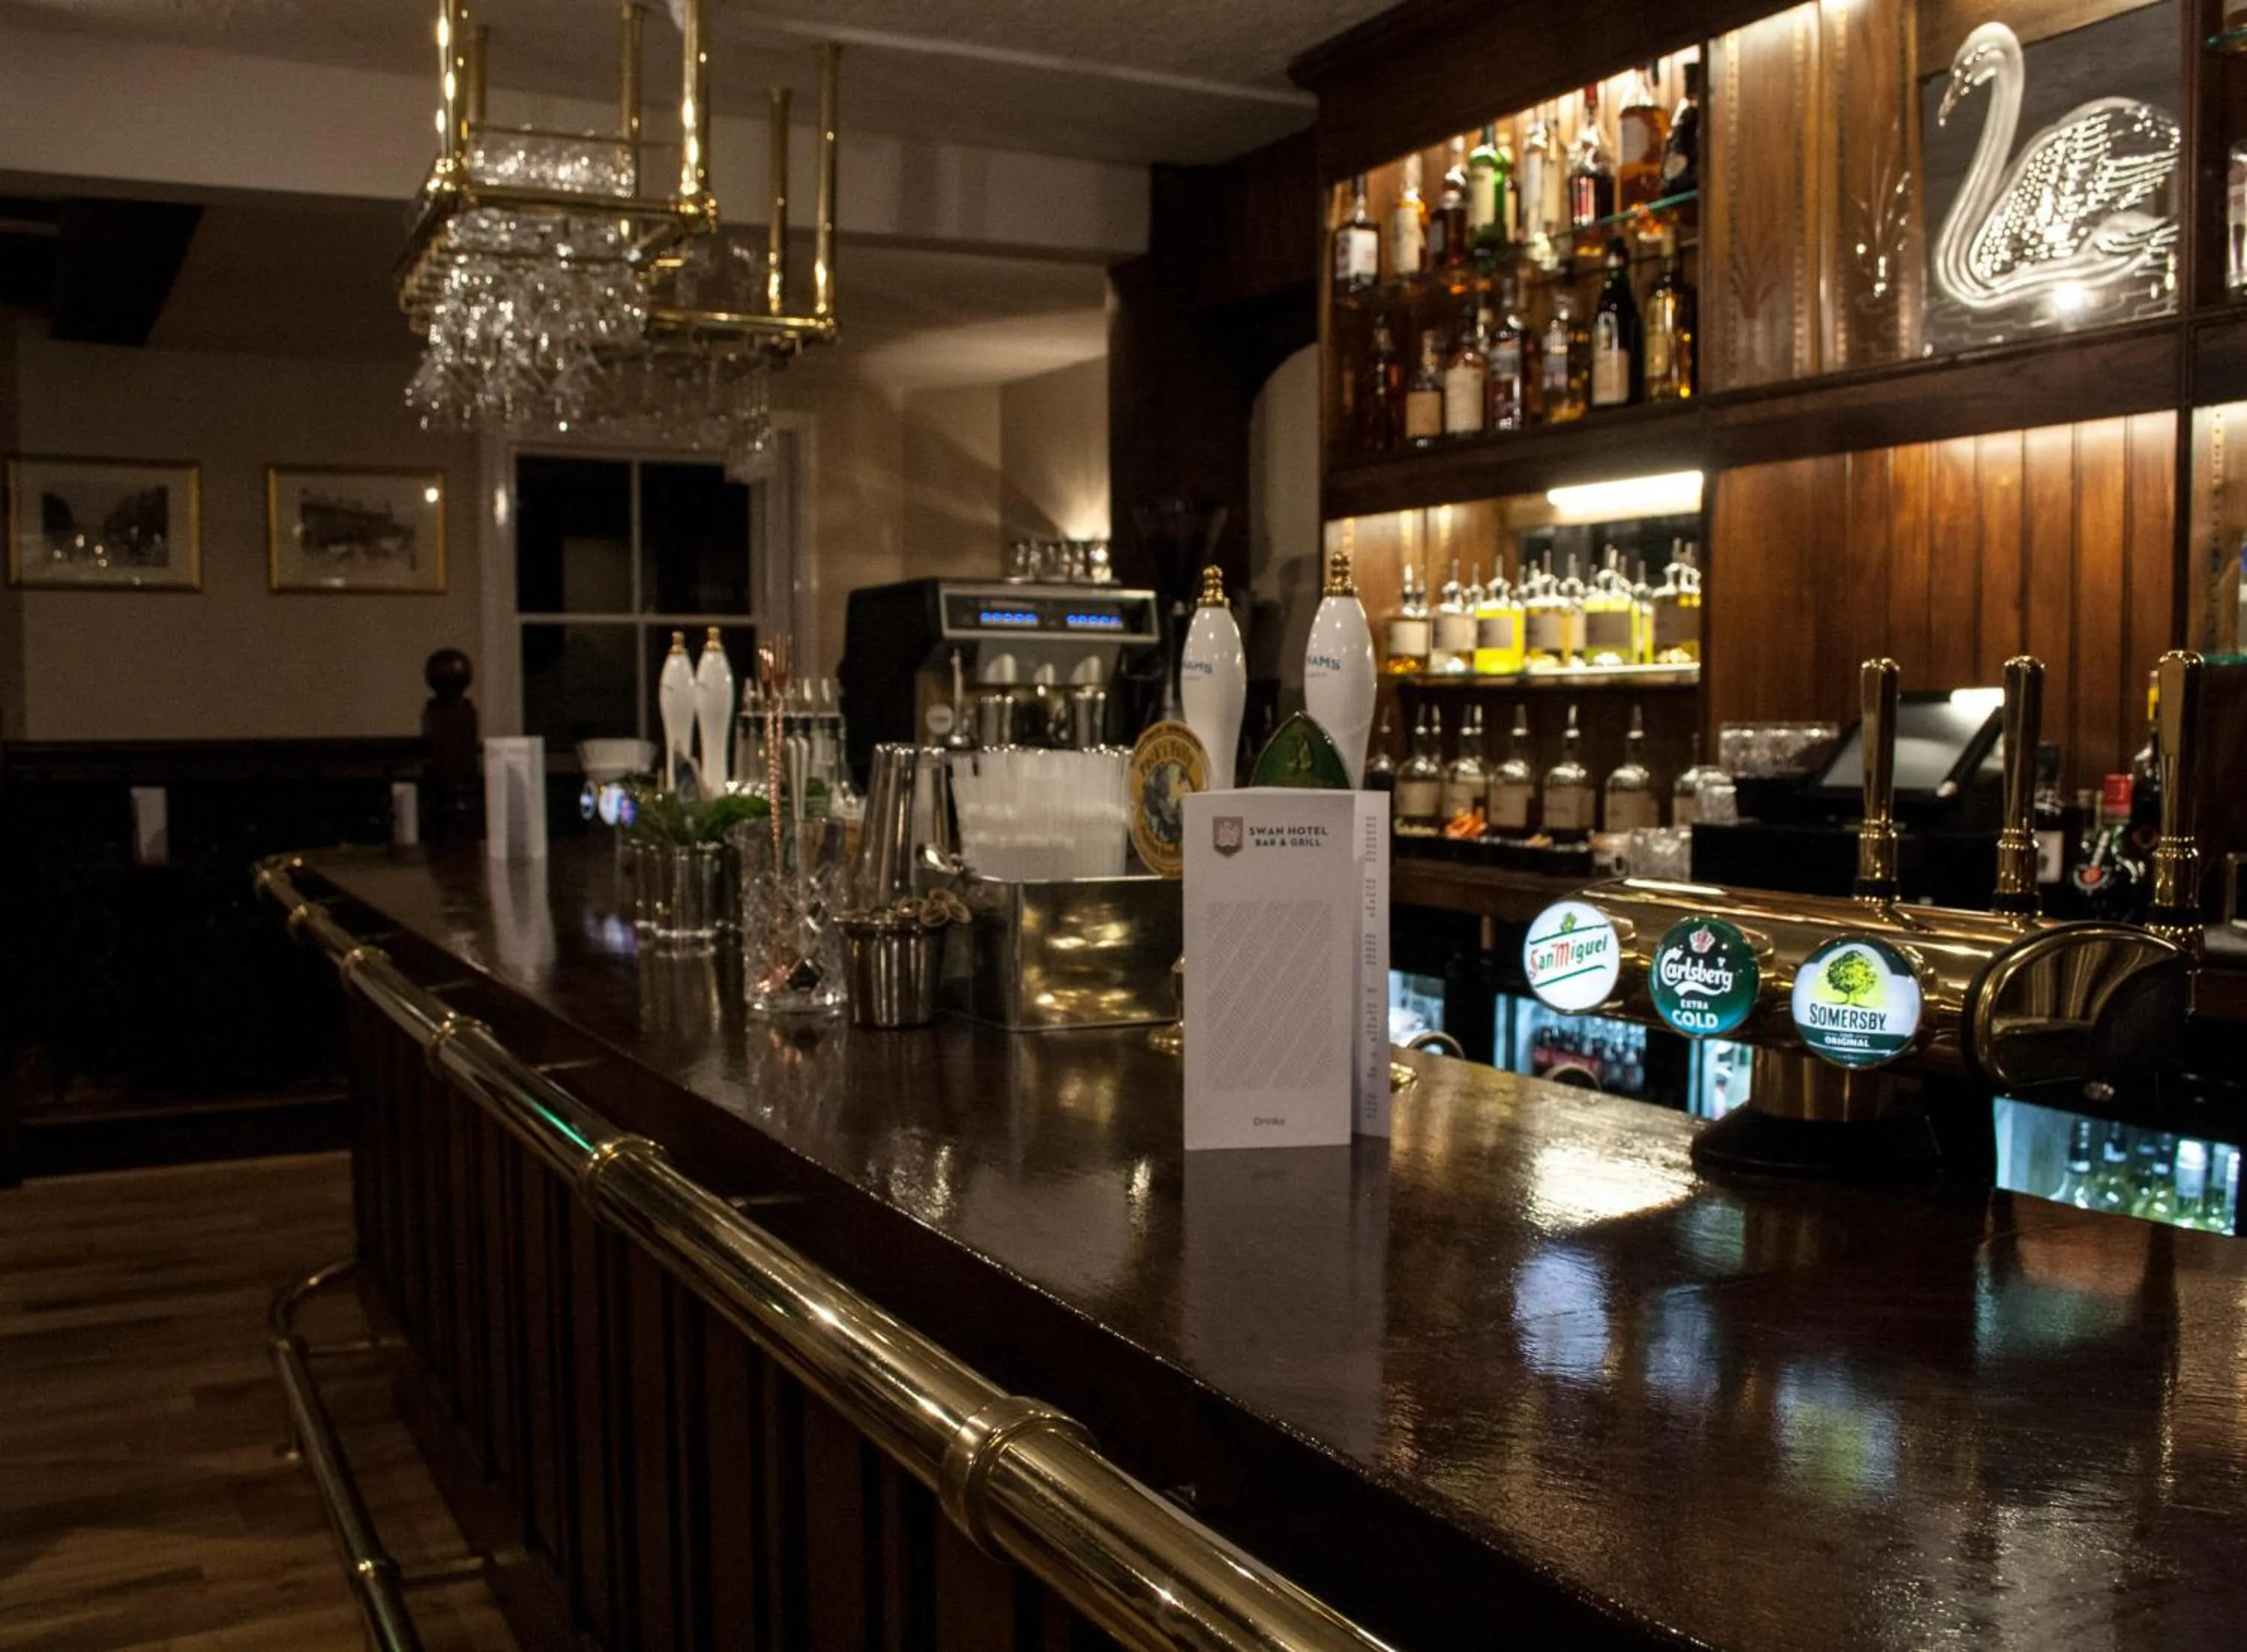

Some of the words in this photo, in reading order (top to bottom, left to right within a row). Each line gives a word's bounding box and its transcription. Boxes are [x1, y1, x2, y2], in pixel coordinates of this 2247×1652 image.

[1249, 826, 1283, 836] SWAN
[1288, 826, 1328, 836] HOTEL
[1255, 838, 1276, 847] BAR
[1291, 838, 1321, 847] GRILL
[1660, 947, 1734, 994] Carlsberg
[1680, 999, 1708, 1010] EXTRA
[1672, 1009, 1719, 1029] COLD
[1809, 1003, 1887, 1030] SOMERSBY
[1824, 1036, 1870, 1048] ORIGINAL
